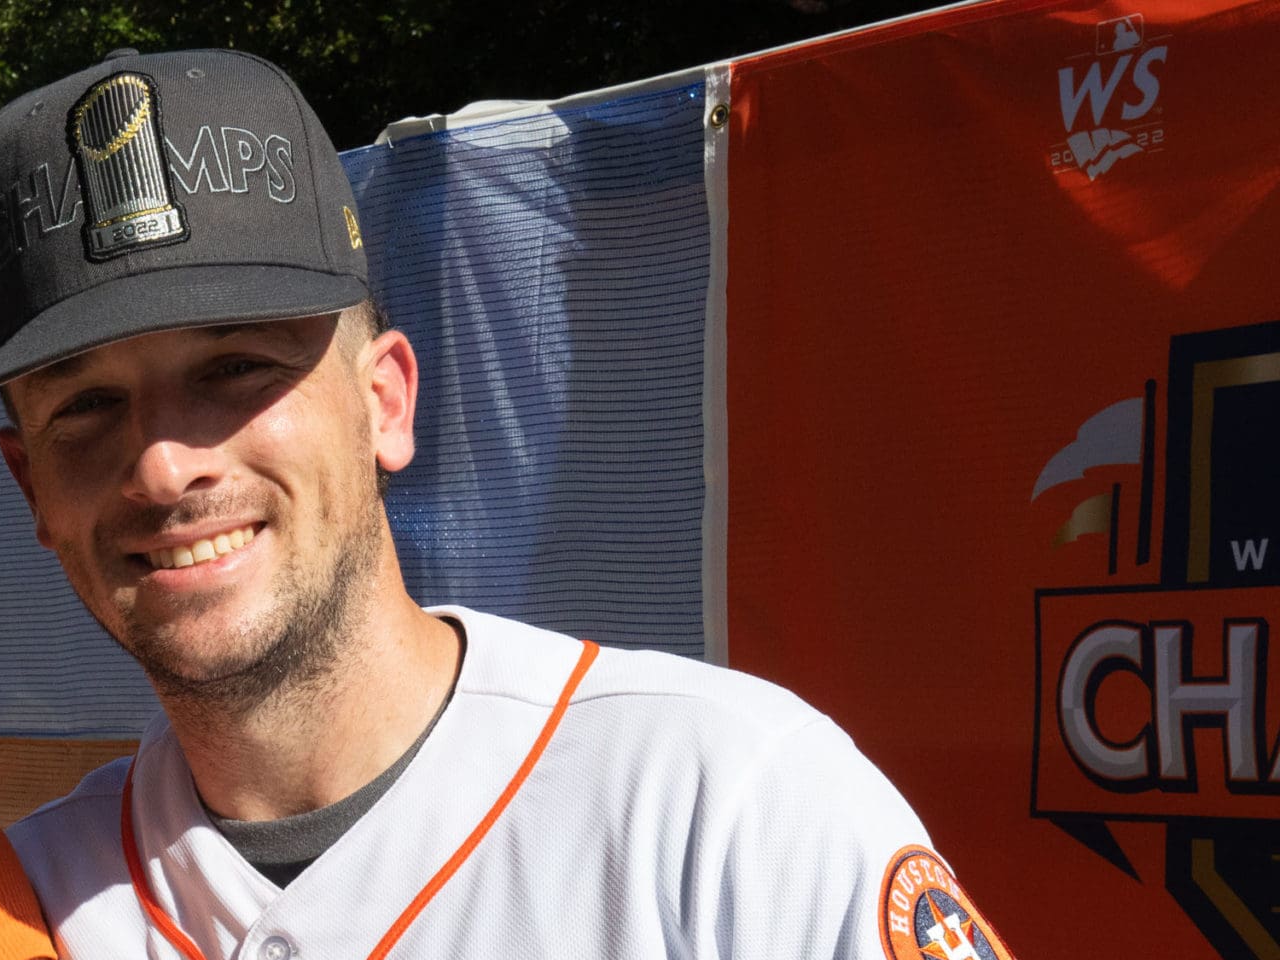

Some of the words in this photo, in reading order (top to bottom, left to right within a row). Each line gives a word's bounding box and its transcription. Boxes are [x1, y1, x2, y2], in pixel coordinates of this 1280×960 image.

[1057, 45, 1168, 132] WS
[112, 219, 160, 242] 2022
[1058, 620, 1280, 790] CH
[889, 857, 961, 937] HOUSTON
